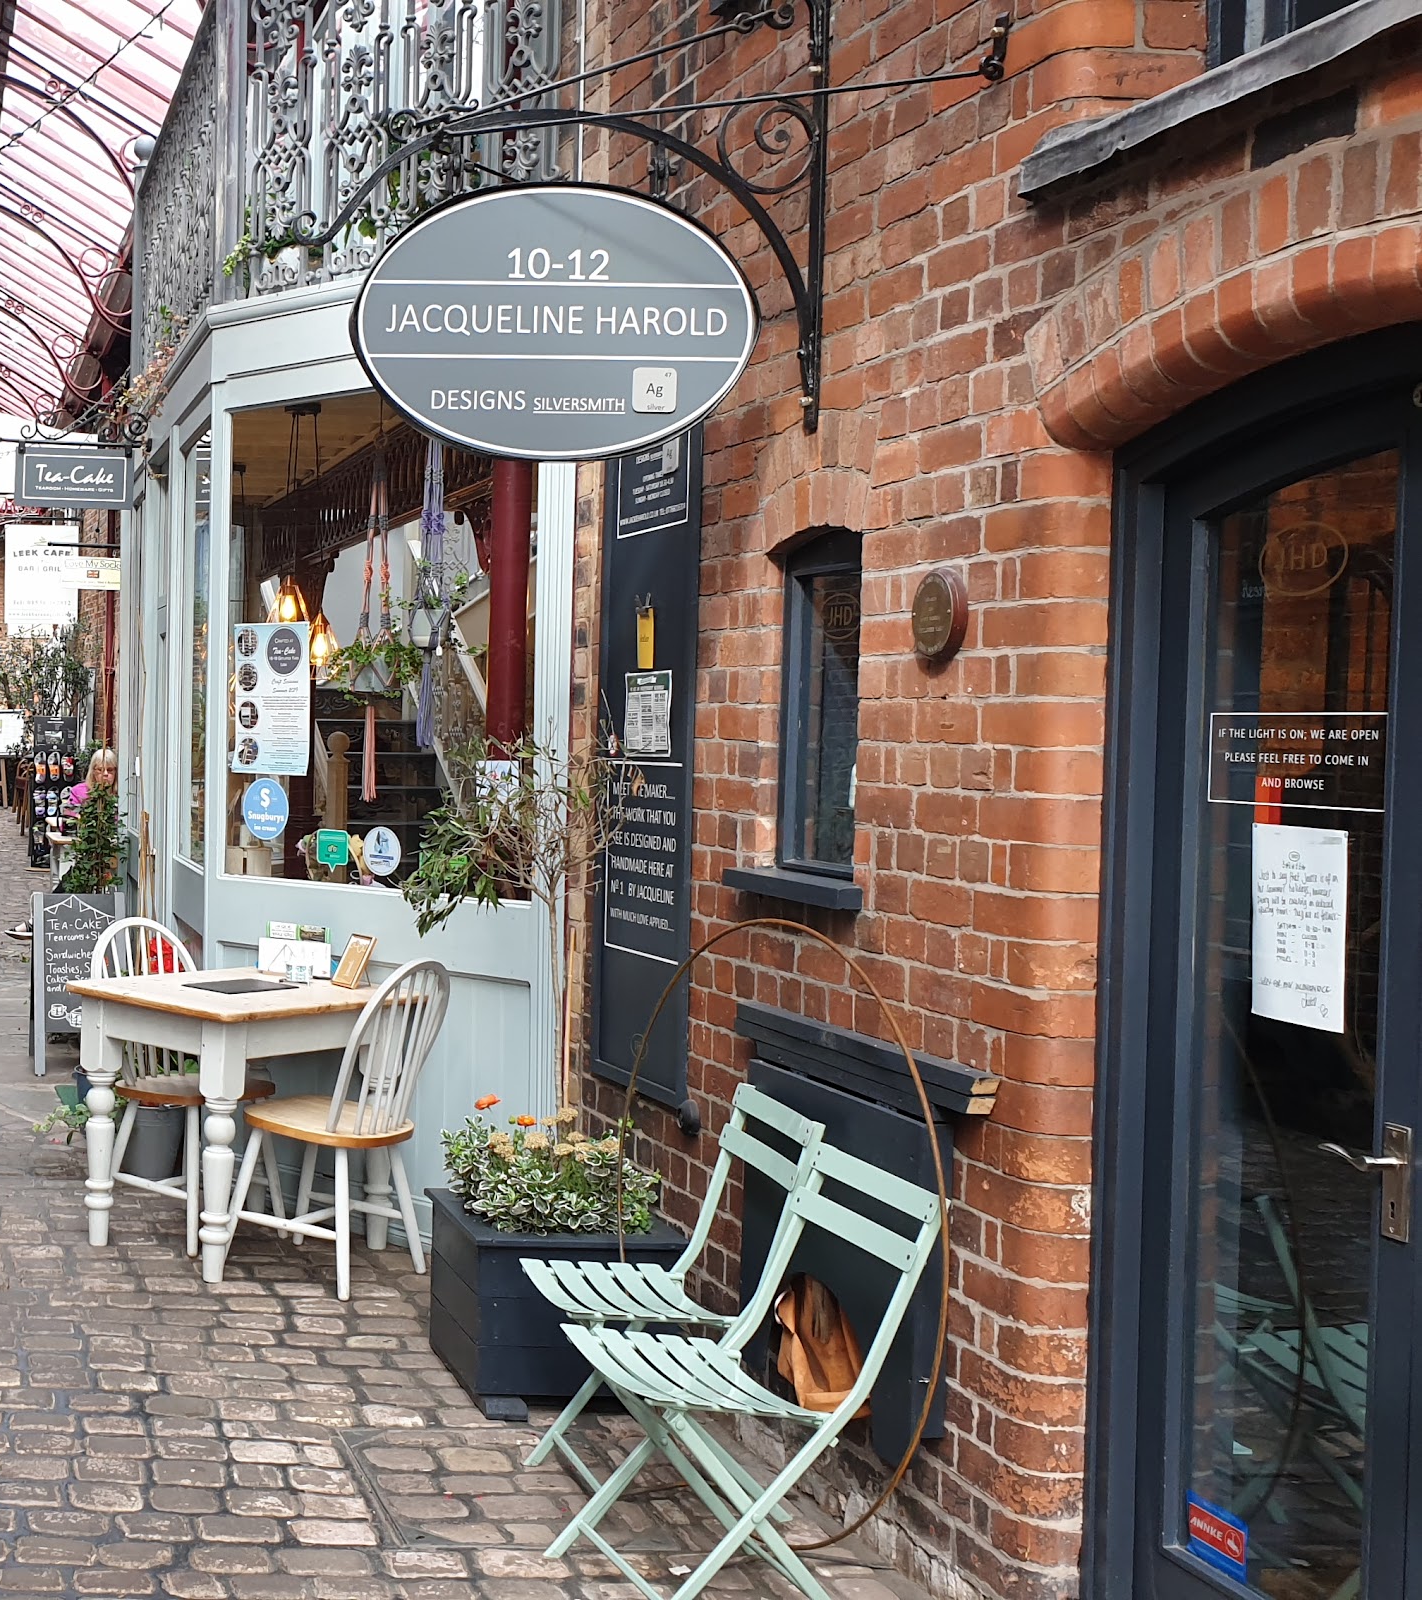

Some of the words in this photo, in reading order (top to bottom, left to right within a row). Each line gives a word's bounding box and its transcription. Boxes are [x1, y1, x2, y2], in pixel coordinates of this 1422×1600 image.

[507, 247, 610, 281] 10-12
[385, 303, 584, 337] JACQUELINE
[596, 306, 729, 337] HAROLD
[646, 382, 664, 398] Ag
[431, 390, 527, 411] DESIGNS
[533, 397, 625, 412] SILVERSMITH
[35, 463, 114, 485] Tea-Cake
[13, 549, 39, 557] LEEK
[43, 549, 71, 557] CAFE
[85, 560, 98, 570] My
[827, 606, 853, 627] JHD
[1218, 729, 1226, 738] IF
[1229, 729, 1245, 738] THE
[1249, 729, 1276, 739] LIGHT
[1278, 729, 1287, 739] IS
[1310, 730, 1325, 740] WE
[1328, 730, 1347, 740] ARE
[1350, 730, 1379, 740] OPEN
[1224, 752, 1256, 763] PLEASE
[1258, 753, 1280, 763] FEEL
[1283, 753, 1305, 764] FREE
[1309, 754, 1322, 765] TO
[1325, 755, 1354, 766] COME
[1357, 756, 1369, 766] IN
[1261, 778, 1281, 788] AND
[1284, 779, 1324, 790] BROWSE
[247, 810, 284, 824] Snugburys
[626, 808, 645, 822] WORK
[646, 810, 662, 824] THAT
[663, 812, 676, 826] YOU
[624, 832, 630, 846] IS
[631, 833, 662, 851] DESIGNED
[662, 837, 676, 852] AND
[611, 855, 647, 875] HANDMADE
[648, 861, 665, 877] HERE
[665, 863, 674, 878] AT
[628, 882, 636, 897] BY
[636, 884, 674, 905] JACQUELINE
[610, 906, 623, 920] WITH
[623, 910, 637, 923] MUCH
[637, 913, 648, 926] LOVE
[1189, 1516, 1224, 1542] ANNKE
